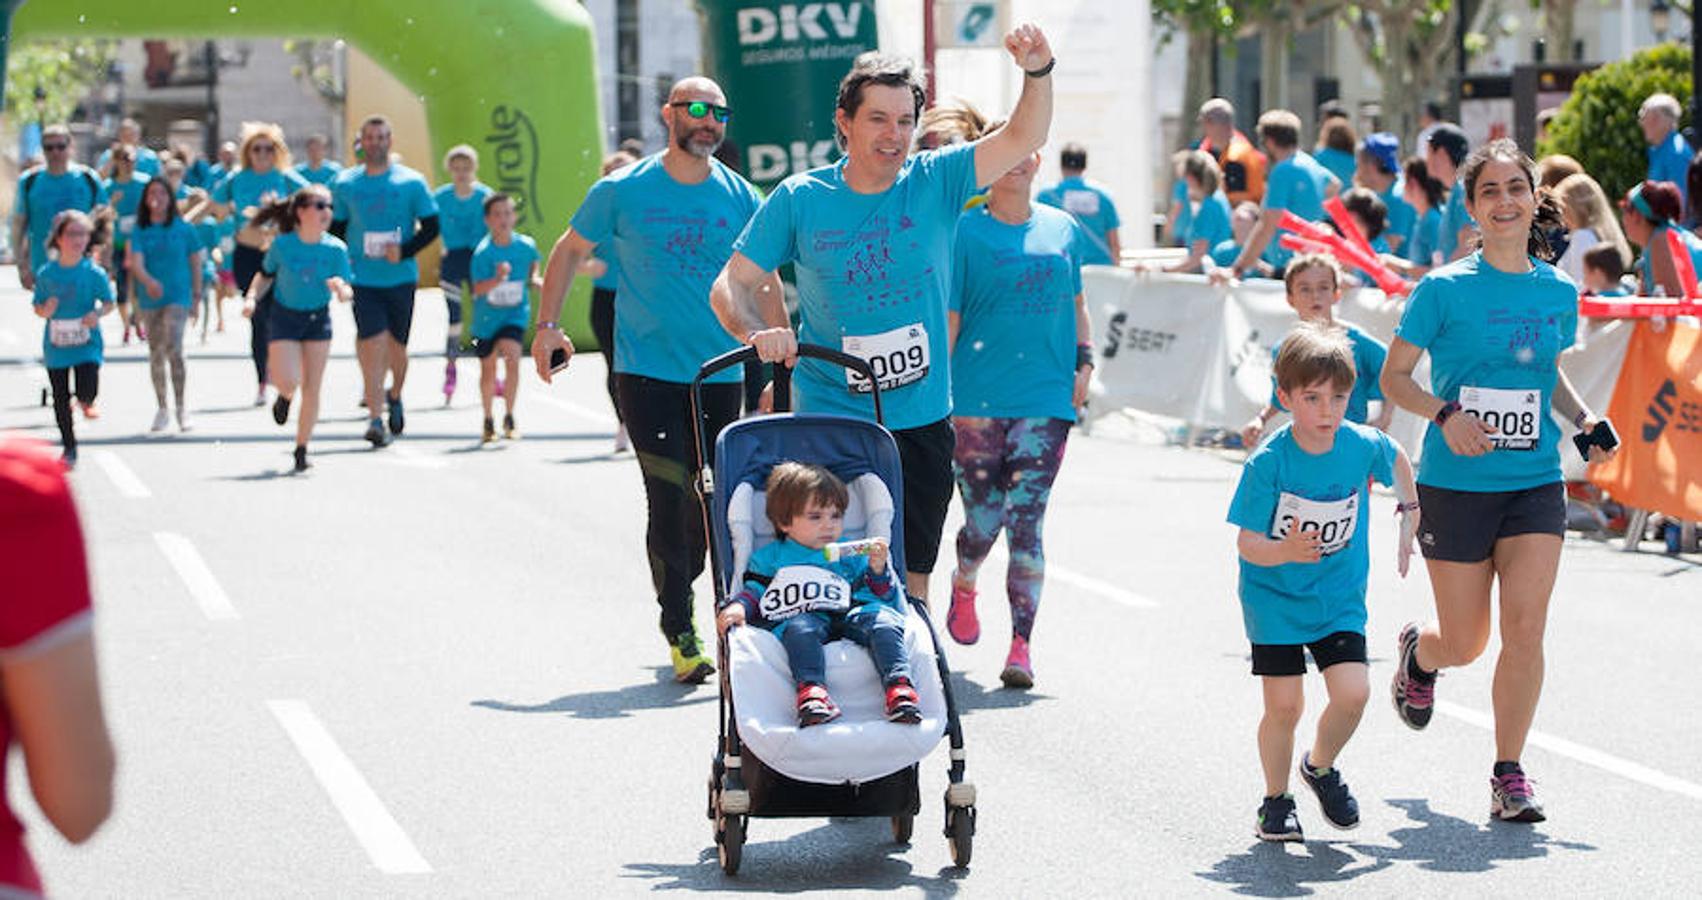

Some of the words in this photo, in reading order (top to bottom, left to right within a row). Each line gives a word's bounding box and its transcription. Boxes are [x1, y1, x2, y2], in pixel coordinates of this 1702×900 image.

[737, 2, 862, 45] DKV
[748, 139, 836, 180] DK
[765, 581, 841, 611] 3006
